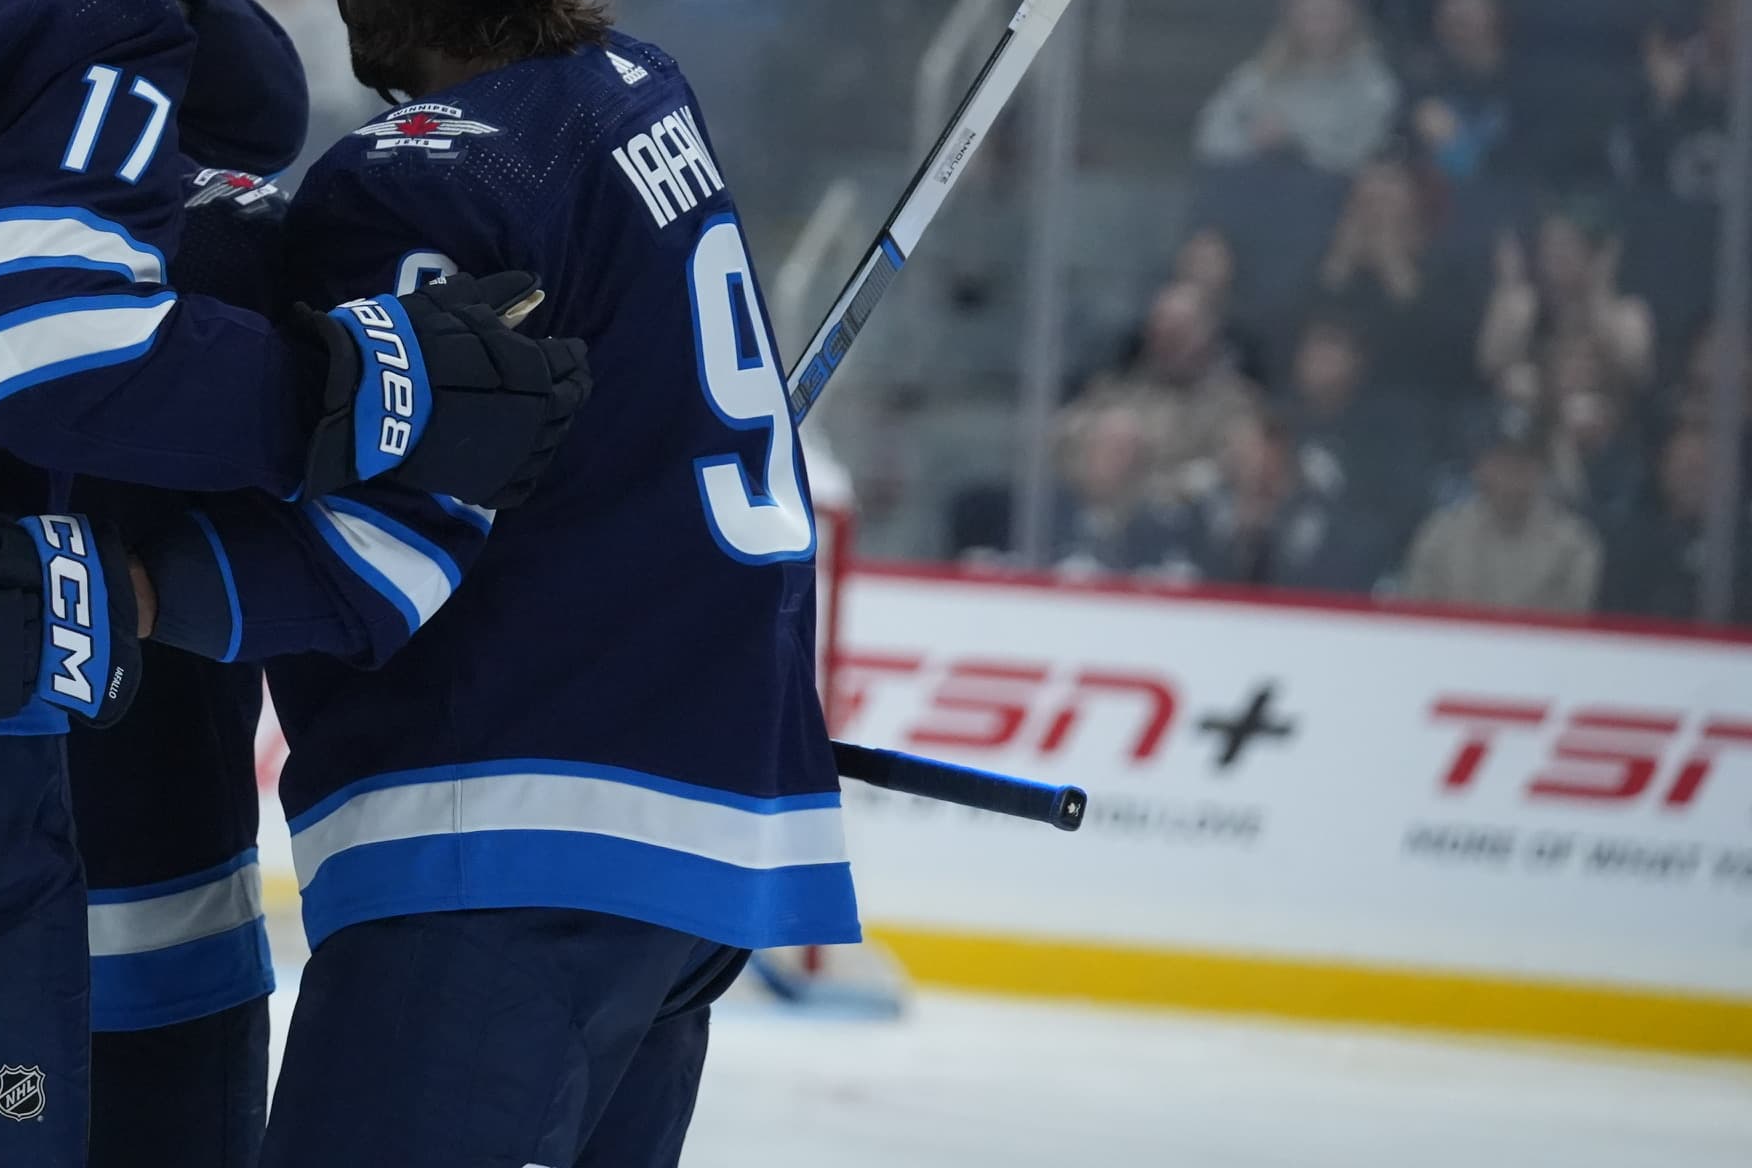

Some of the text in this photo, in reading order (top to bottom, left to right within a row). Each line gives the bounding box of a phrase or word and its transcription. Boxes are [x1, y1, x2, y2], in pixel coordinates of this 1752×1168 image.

[60, 64, 173, 187] 17
[394, 139, 431, 147] JETS
[611, 105, 726, 229] IAFA
[685, 213, 817, 567] 9
[38, 514, 93, 704] CCM
[108, 665, 125, 700] IAFALLO
